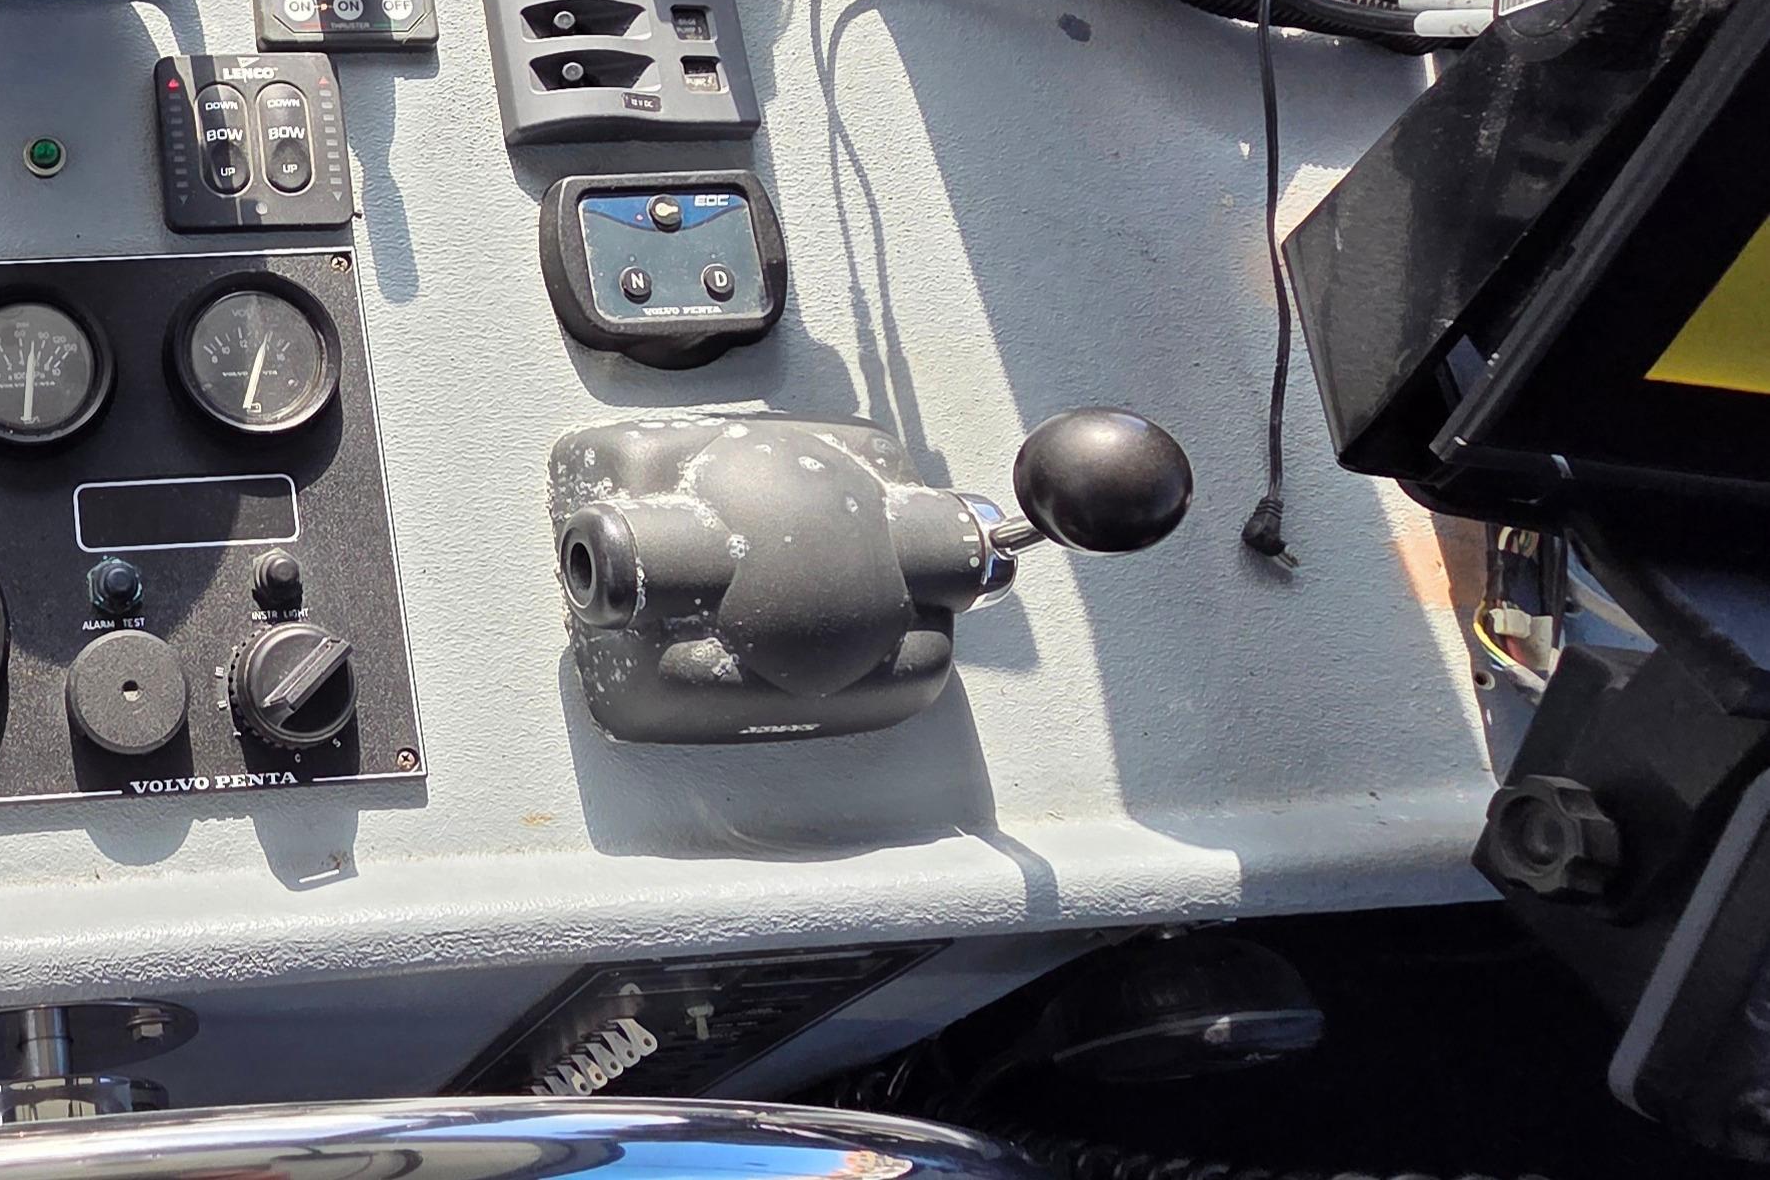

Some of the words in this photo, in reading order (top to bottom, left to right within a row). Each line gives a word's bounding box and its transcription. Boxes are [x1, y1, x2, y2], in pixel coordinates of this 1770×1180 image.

[288, 1, 311, 12] ON
[337, 1, 360, 12] ON
[383, 0, 411, 11] OFF
[330, 22, 370, 30] THRUSTER
[222, 67, 276, 80] LENCO
[205, 101, 239, 111] DOWN
[266, 99, 301, 109] DOWN
[206, 128, 244, 141] BOW
[267, 126, 306, 140] BOW
[220, 167, 236, 177] UP
[282, 163, 299, 174] UP
[631, 273, 645, 289] N
[714, 271, 728, 287] D
[642, 306, 680, 316] VOLVO
[682, 305, 723, 315] PENTA
[251, 610, 279, 620] INSTR
[283, 608, 309, 619] LIGHT
[82, 619, 116, 631] ALARM
[123, 617, 146, 627] TEST
[130, 776, 211, 794] VOLVO
[214, 771, 299, 788] PENTA
